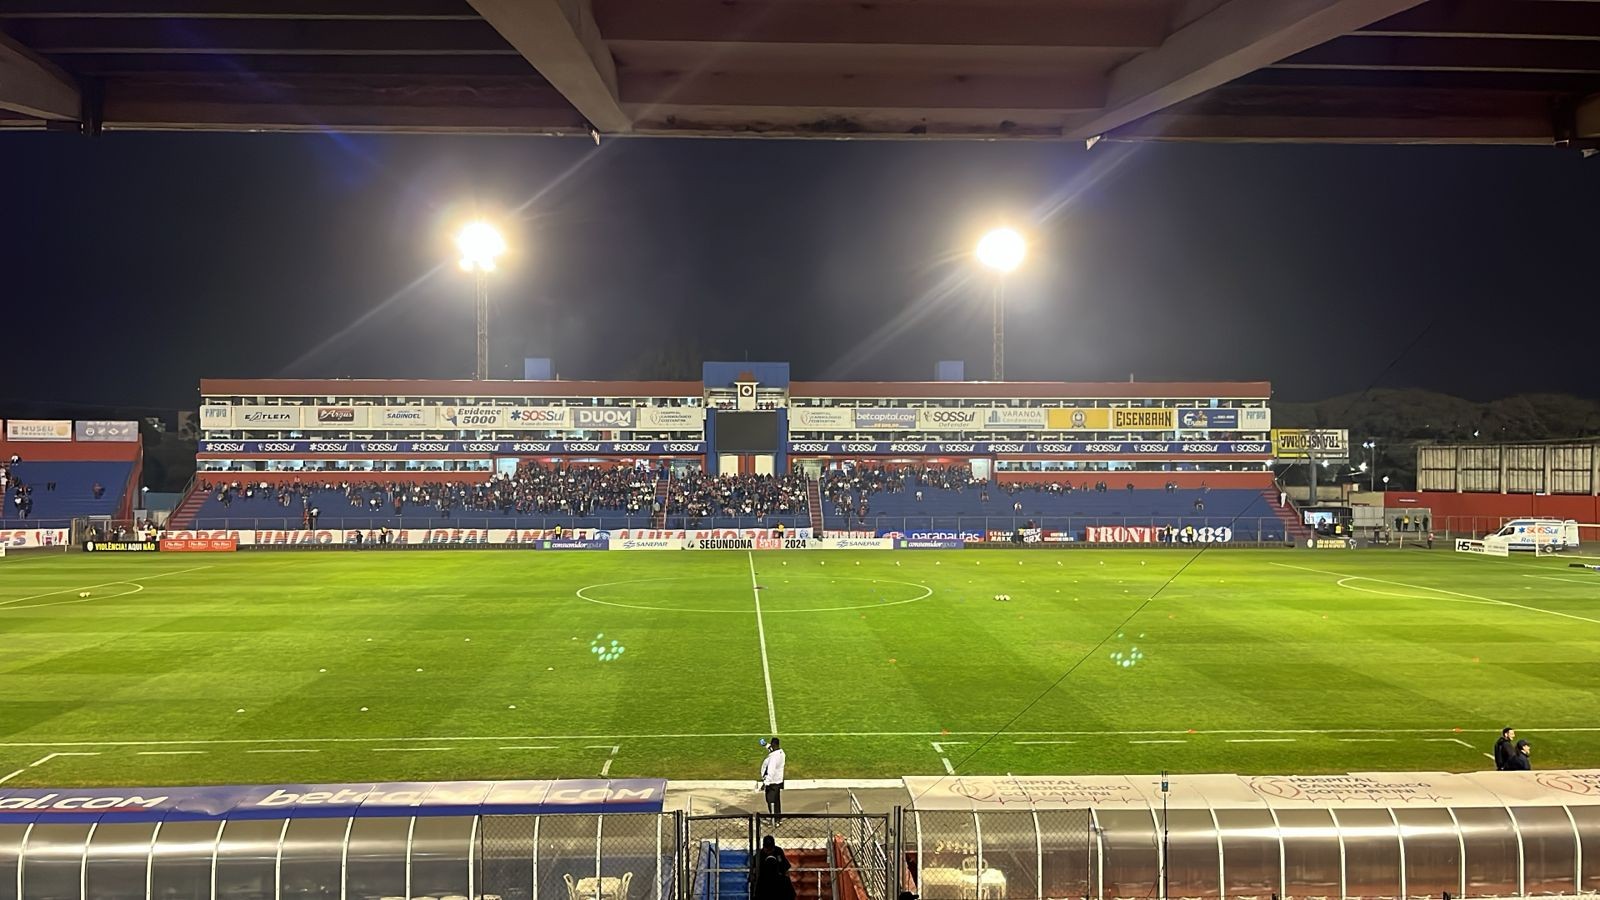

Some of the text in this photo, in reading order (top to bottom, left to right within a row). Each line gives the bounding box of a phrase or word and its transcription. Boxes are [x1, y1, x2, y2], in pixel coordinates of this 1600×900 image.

[462, 416, 497, 424] 5000
[521, 410, 565, 421] SOSSul
[580, 410, 631, 423] DUOM
[933, 411, 975, 422] SOSSul
[1116, 411, 1172, 427] EISENBAHN
[1280, 435, 1340, 448] TRANSFORMA
[128, 542, 142, 551] AQUI
[699, 539, 753, 549] SEGUNDONA
[784, 539, 807, 549] 2024
[0, 793, 169, 809] al.com
[255, 786, 655, 807] betcaal.com
